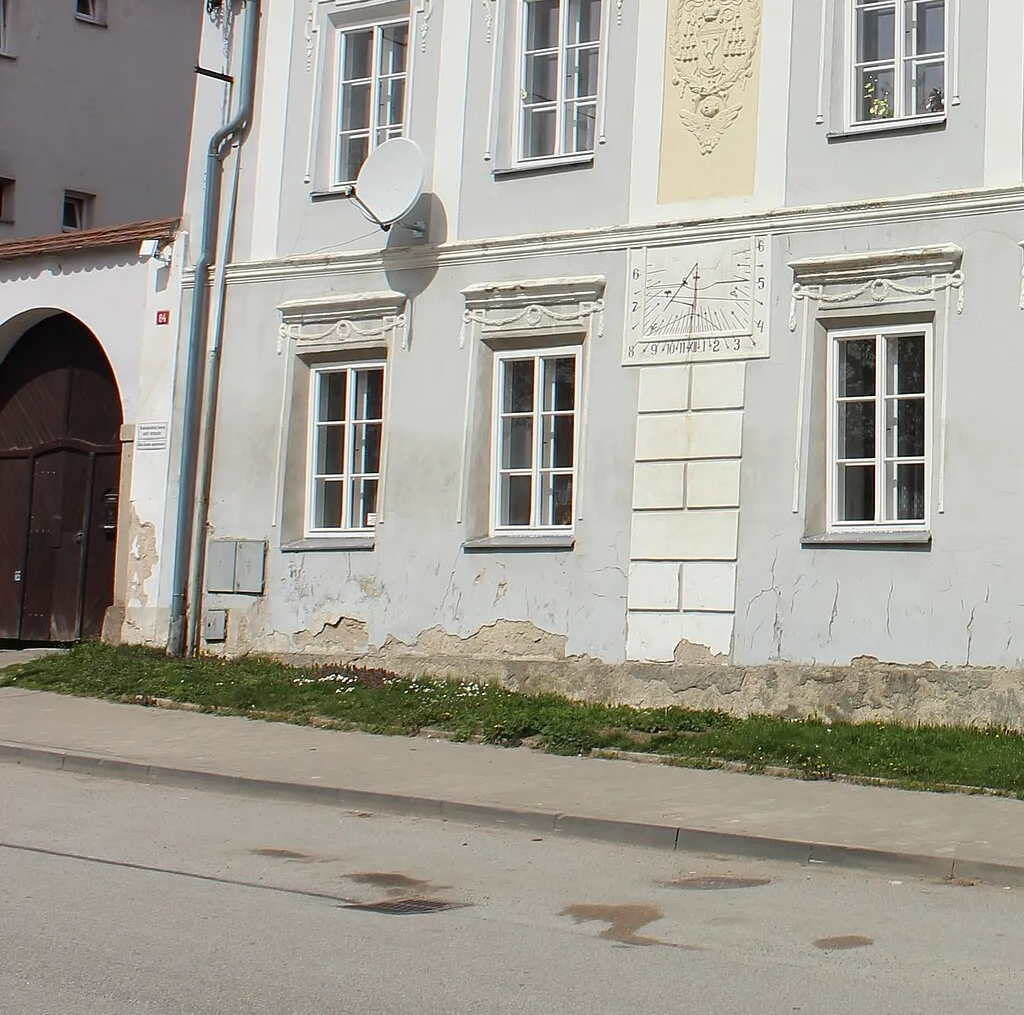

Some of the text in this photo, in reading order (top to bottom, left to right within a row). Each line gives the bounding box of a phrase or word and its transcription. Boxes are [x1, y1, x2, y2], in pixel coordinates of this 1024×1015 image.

[758, 239, 765, 252] 6
[632, 269, 639, 280] 6
[758, 277, 765, 290] 5
[632, 302, 639, 312] 7
[757, 320, 765, 332] 4
[628, 346, 635, 357] 8
[650, 344, 658, 355] 9
[666, 342, 675, 354] 10
[679, 342, 685, 353] 11
[712, 340, 720, 352] 2
[733, 339, 741, 350] 3
